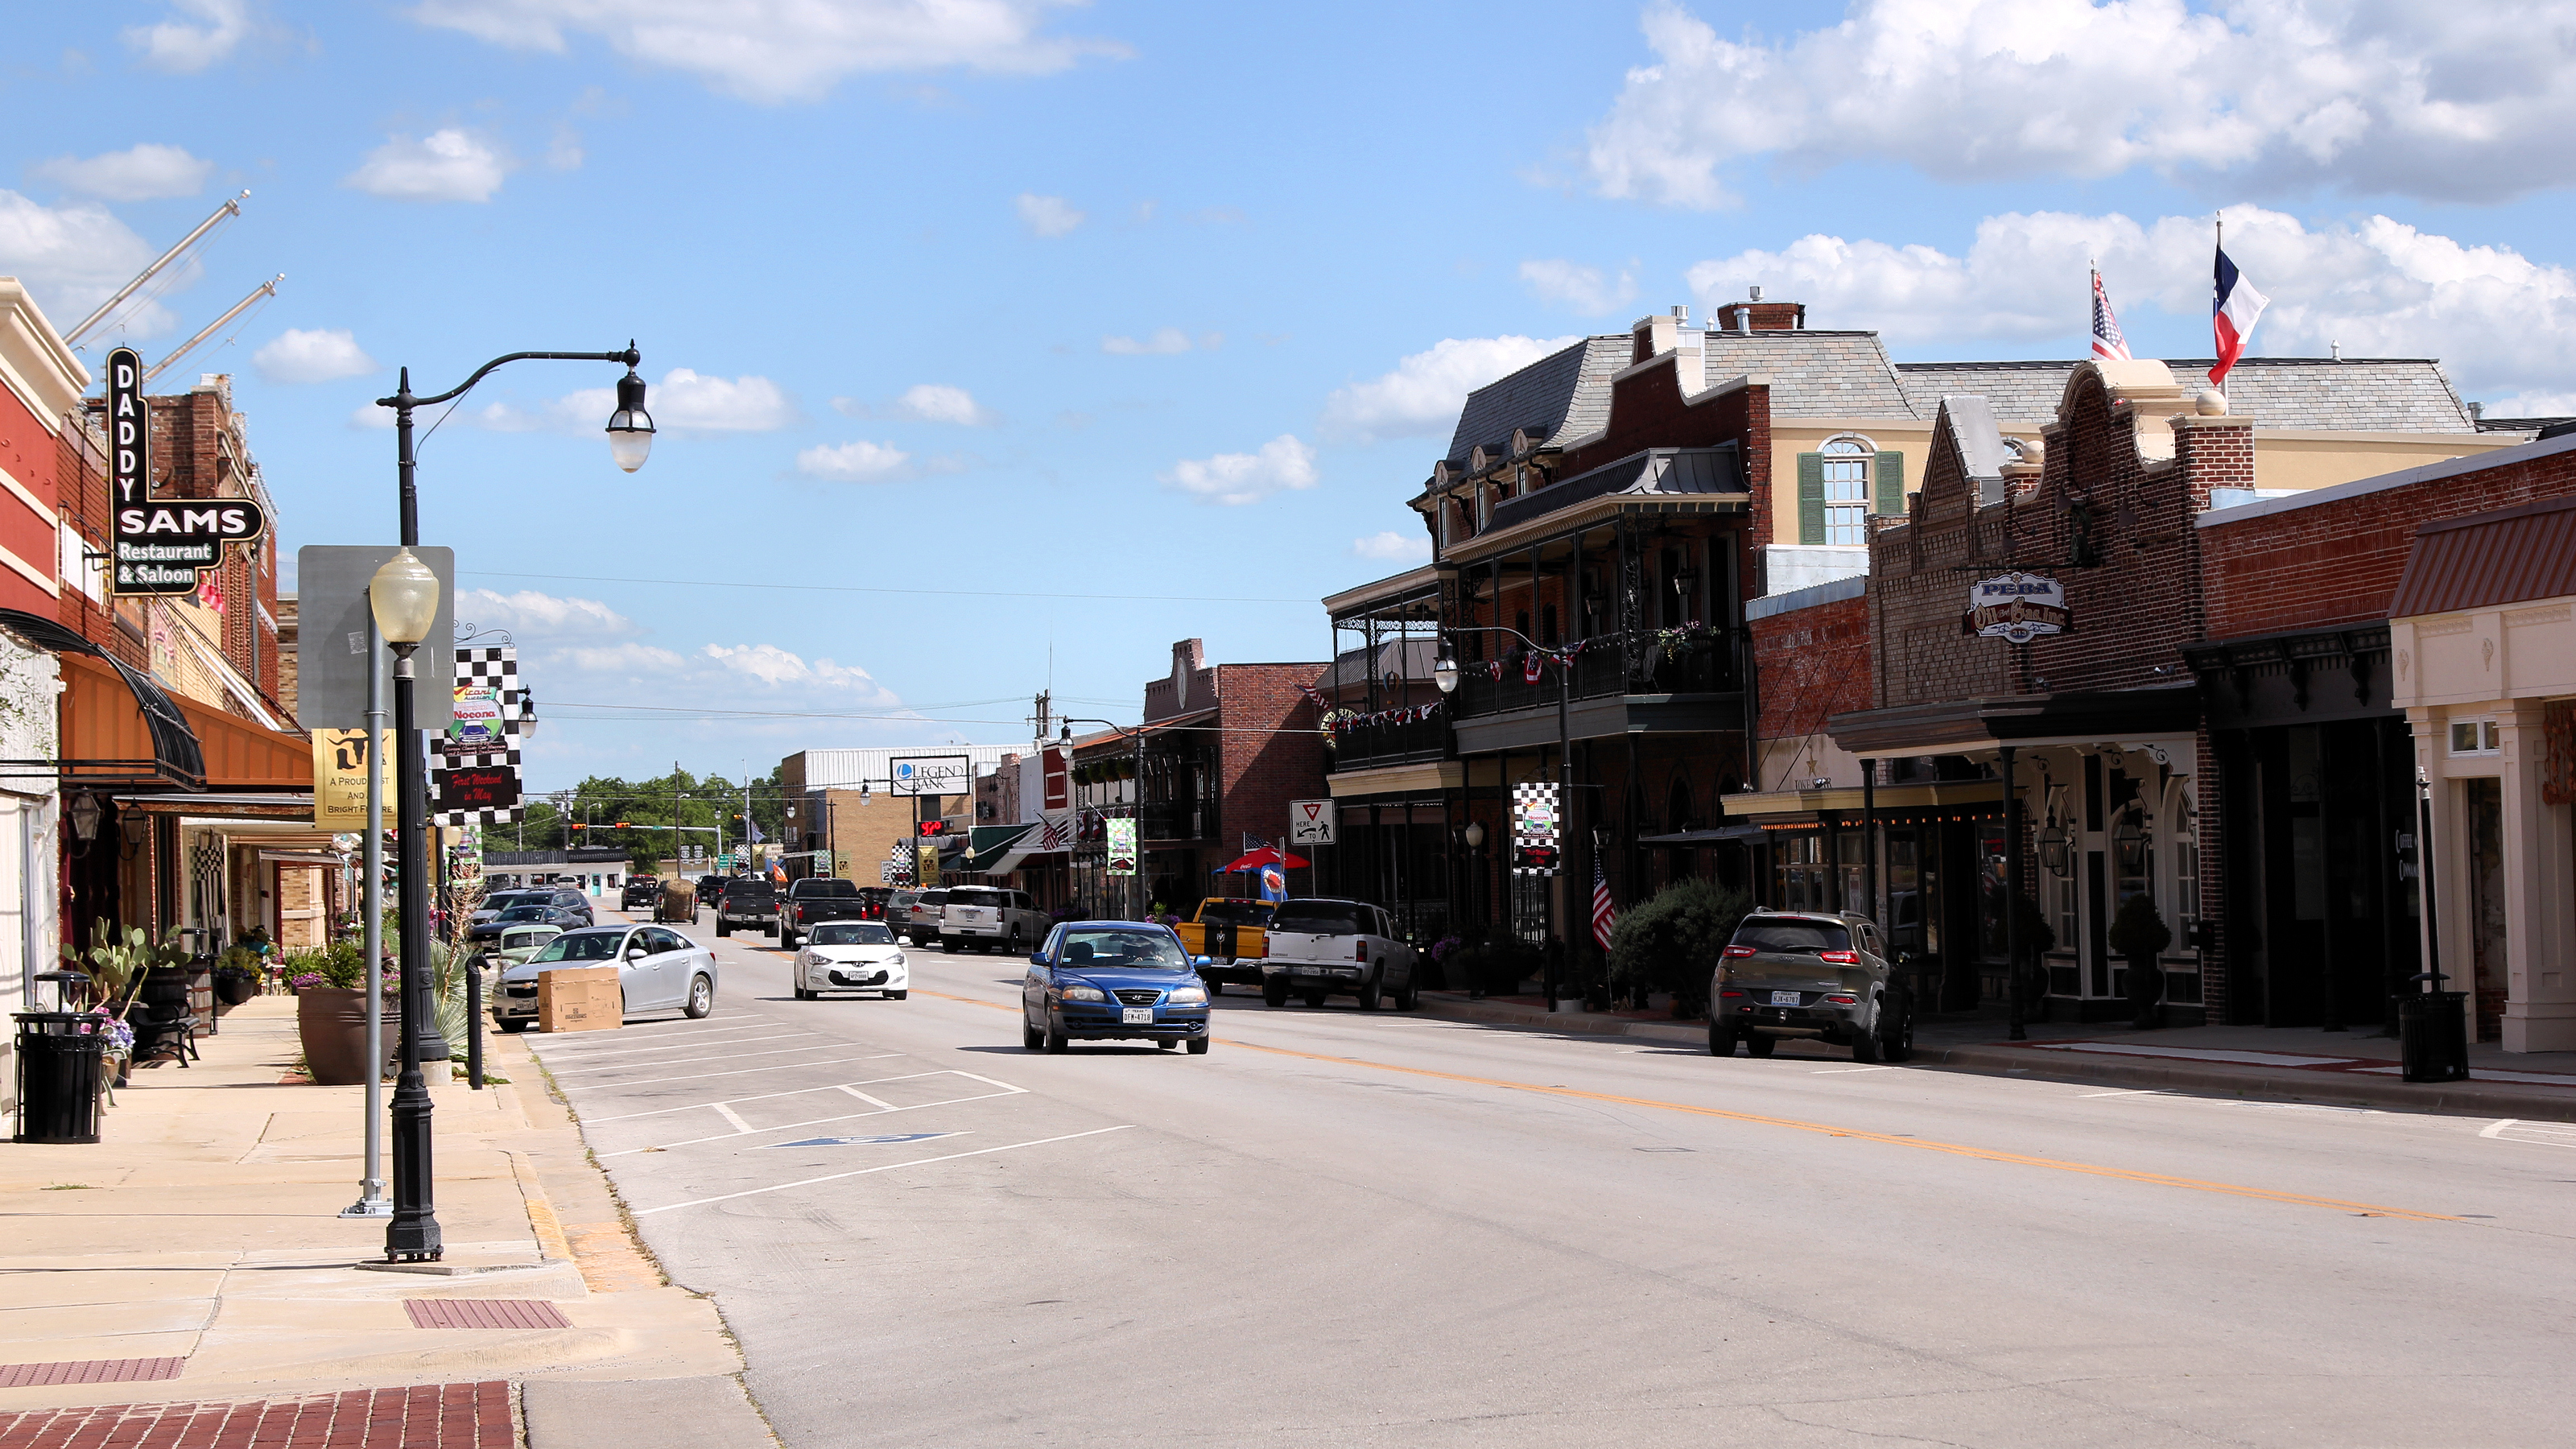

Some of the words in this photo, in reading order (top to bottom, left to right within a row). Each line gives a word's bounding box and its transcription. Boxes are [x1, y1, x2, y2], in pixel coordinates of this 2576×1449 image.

[118, 365, 136, 502] DADDY
[121, 510, 246, 534] SAMS
[118, 542, 212, 560] Restaurant
[118, 565, 135, 584] &
[135, 566, 194, 584] Saloon
[1982, 583, 2053, 596] PEBA
[1975, 602, 1999, 630] Oil
[454, 711, 496, 719] Nocona
[912, 765, 964, 778] LEGEND
[329, 778, 336, 786] A
[339, 777, 367, 786] PROUD
[452, 774, 470, 788] First
[472, 773, 502, 785] Weekend
[914, 778, 947, 790] BANK
[464, 791, 472, 800] in
[473, 788, 492, 802] May
[328, 805, 358, 813] BRIGHT
